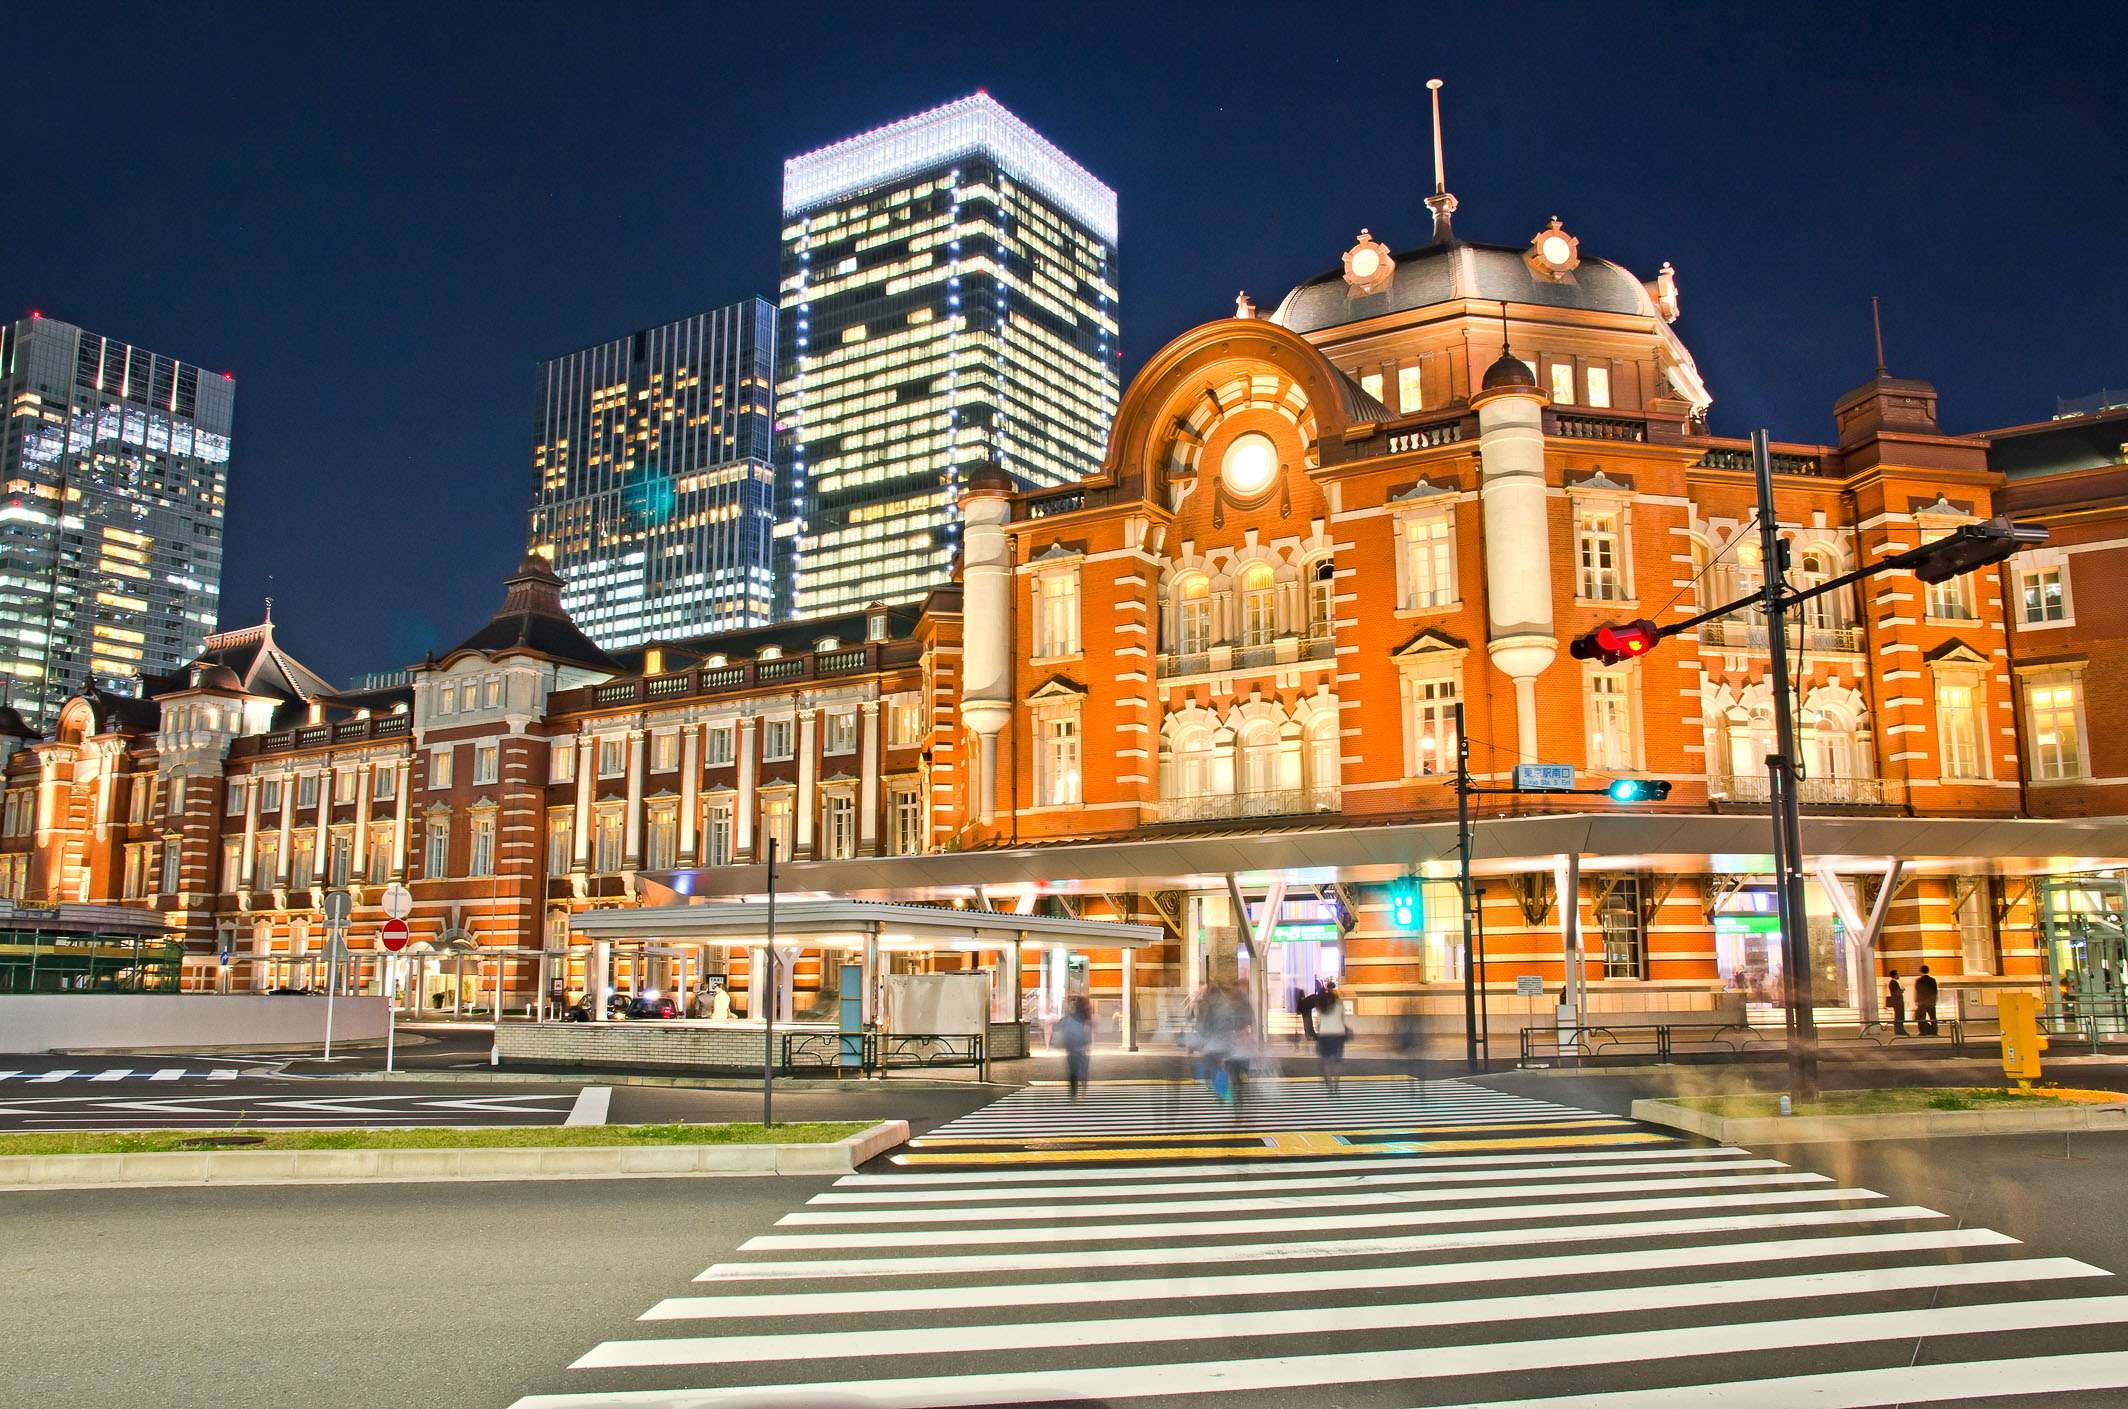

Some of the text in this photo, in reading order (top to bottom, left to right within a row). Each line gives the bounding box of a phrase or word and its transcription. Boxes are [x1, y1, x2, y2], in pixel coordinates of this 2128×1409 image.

[1524, 768, 1570, 778] 東京駅南口
